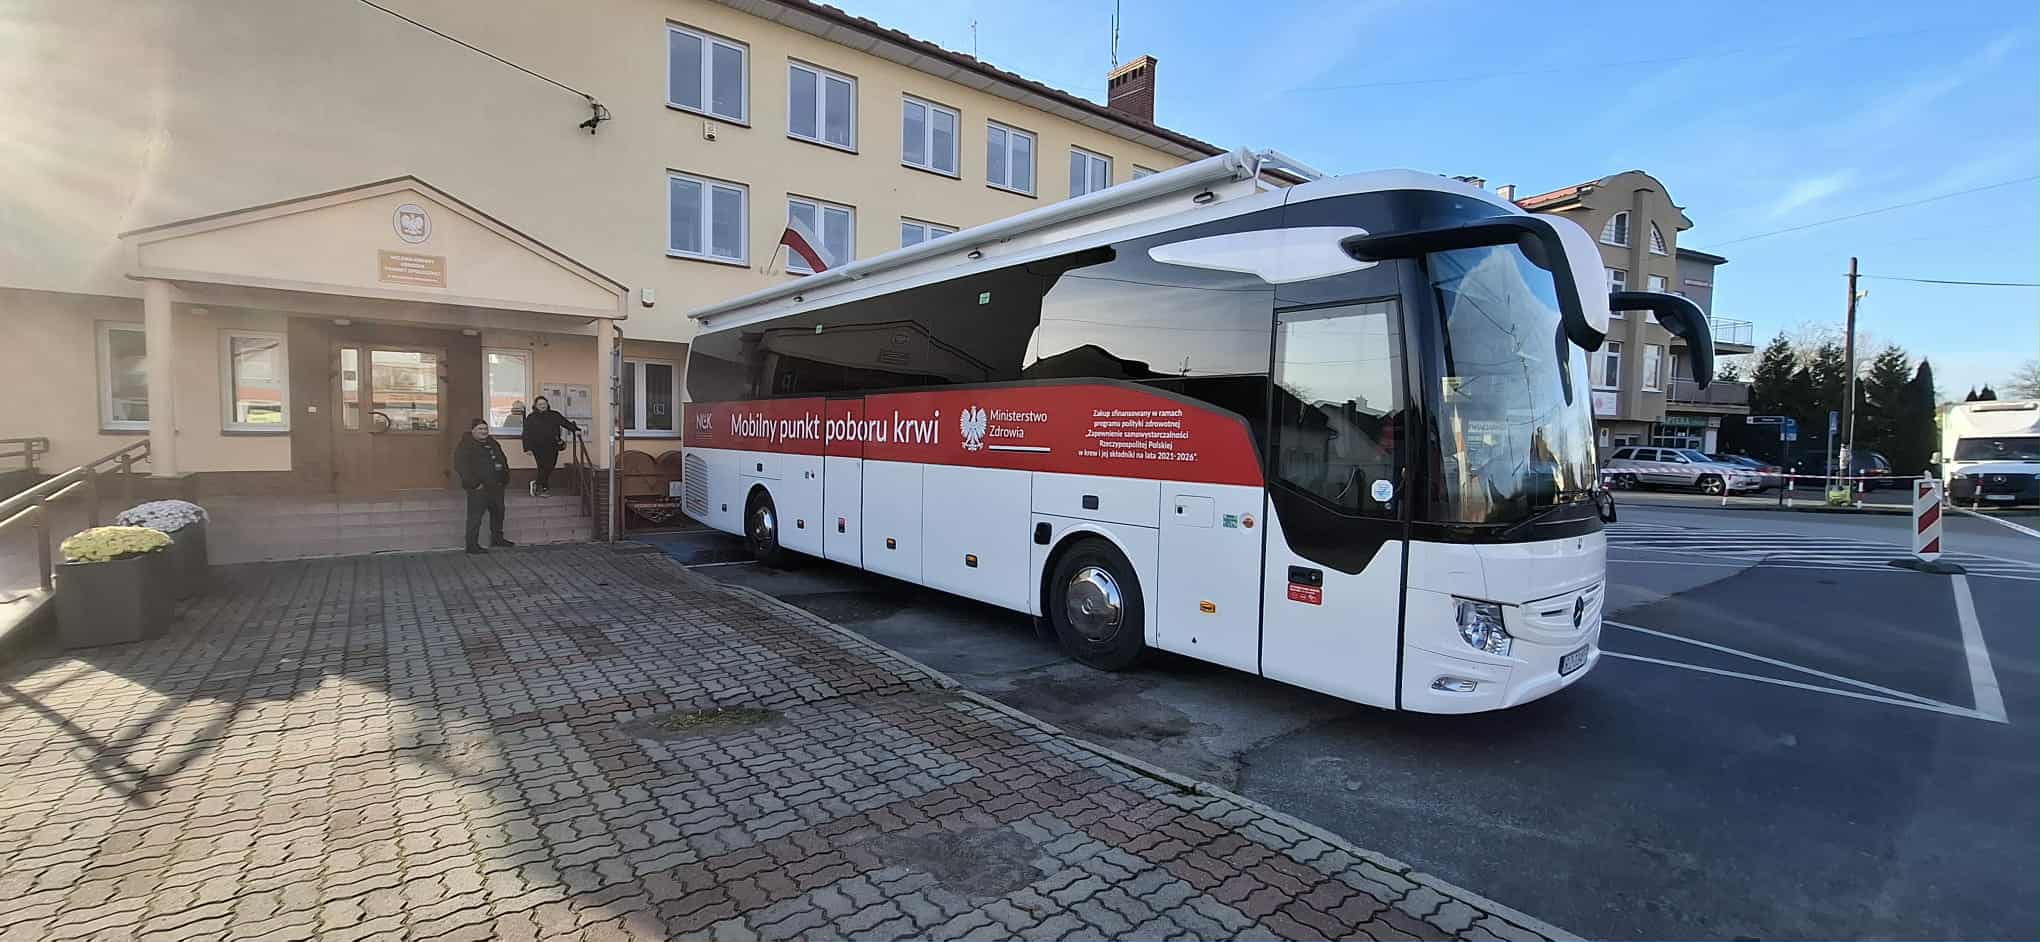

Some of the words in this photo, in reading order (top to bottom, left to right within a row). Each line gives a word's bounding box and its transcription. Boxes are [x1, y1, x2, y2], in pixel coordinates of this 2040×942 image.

[990, 409, 1048, 422] Ministerstwo
[1093, 409, 1110, 418] Zakup
[1111, 409, 1151, 418] sfinansowany
[1159, 409, 1182, 417] ramach
[731, 411, 776, 442] Mobilny
[780, 411, 821, 443] punkt
[825, 411, 887, 446] poboru
[893, 410, 939, 443] krwi
[1121, 420, 1144, 428] polityki
[1145, 420, 1181, 429] zdrowotnej
[989, 425, 1024, 438] Zdrowia
[1100, 440, 1148, 449] Rzeczypospolitej
[1148, 440, 1173, 451] Polskiej
[1101, 449, 1109, 459] jej
[1109, 449, 1136, 458] składniki
[1144, 450, 1157, 459] lata
